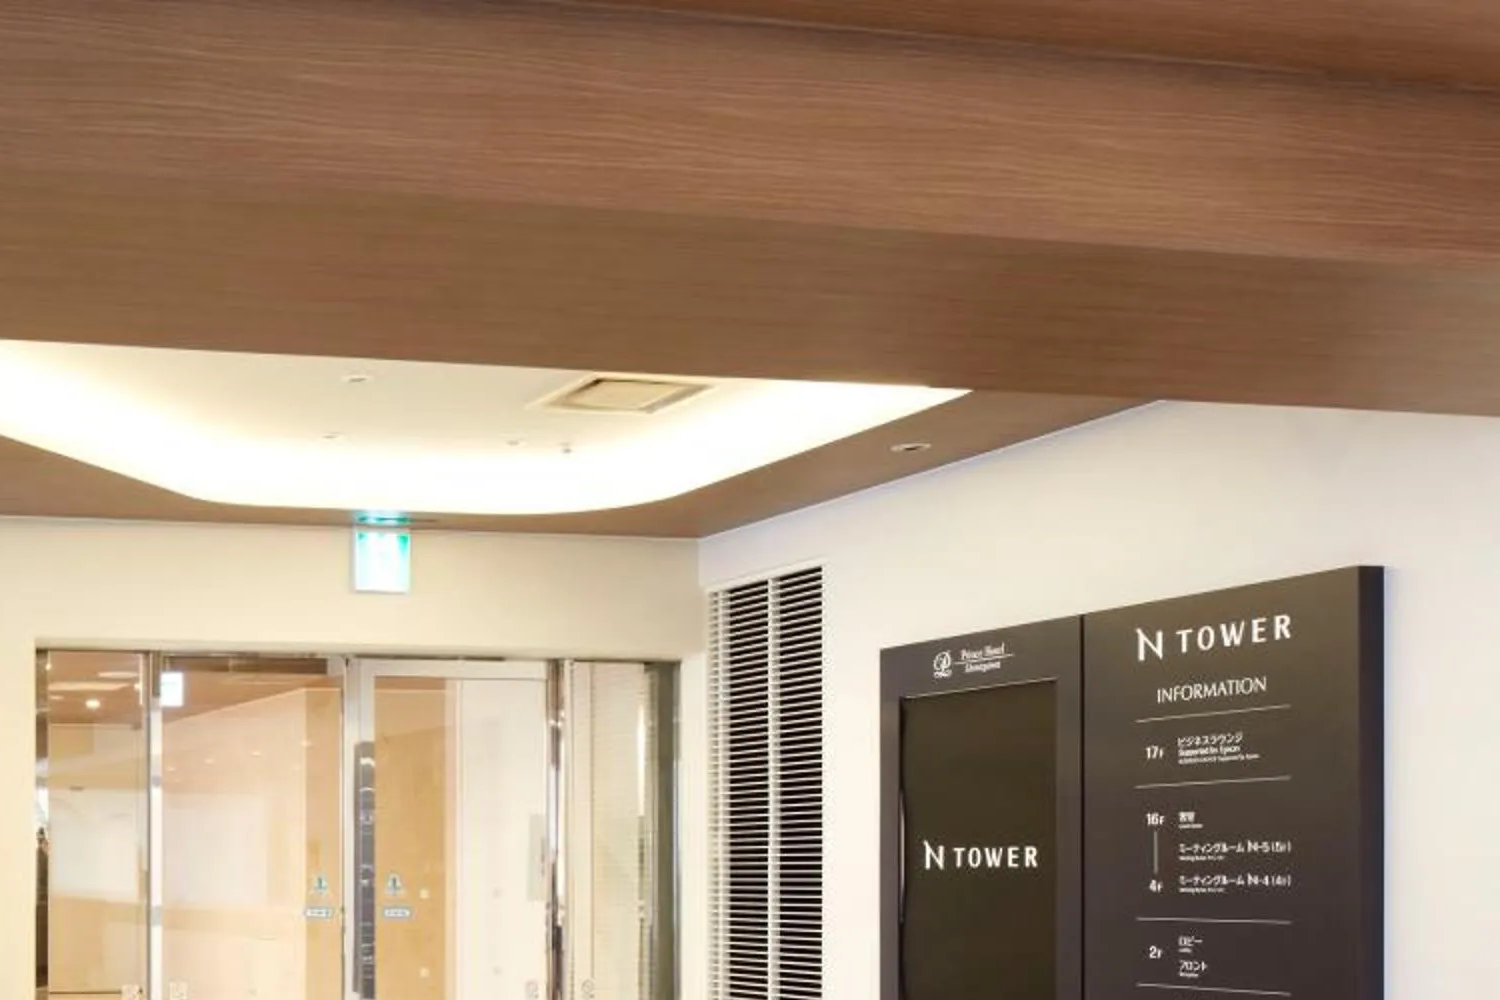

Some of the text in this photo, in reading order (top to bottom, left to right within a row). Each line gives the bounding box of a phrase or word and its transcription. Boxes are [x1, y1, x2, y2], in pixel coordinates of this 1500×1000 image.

[1135, 613, 1292, 662] N TOWER
[1156, 676, 1267, 704] INFORMATION
[923, 839, 1038, 870] N TOWER
